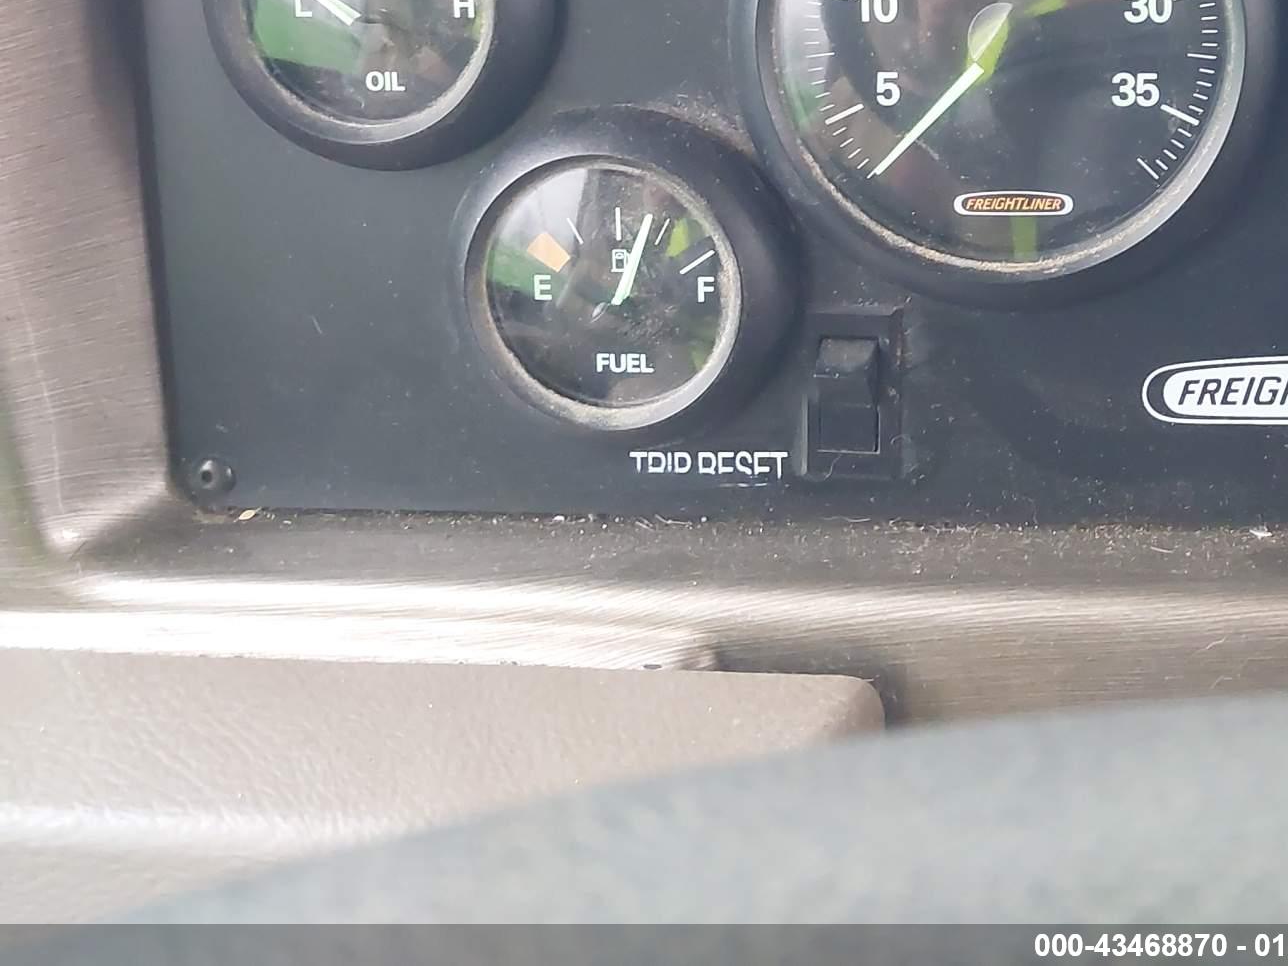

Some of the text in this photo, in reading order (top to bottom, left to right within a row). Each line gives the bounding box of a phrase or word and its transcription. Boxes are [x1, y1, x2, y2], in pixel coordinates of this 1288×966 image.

[365, 71, 406, 91] OIL
[875, 72, 901, 106] 5
[1111, 73, 1160, 107] 35
[965, 196, 1062, 211] FREIGHTLINER
[533, 274, 553, 301] E
[696, 276, 715, 302] F
[595, 353, 655, 373] FUEL
